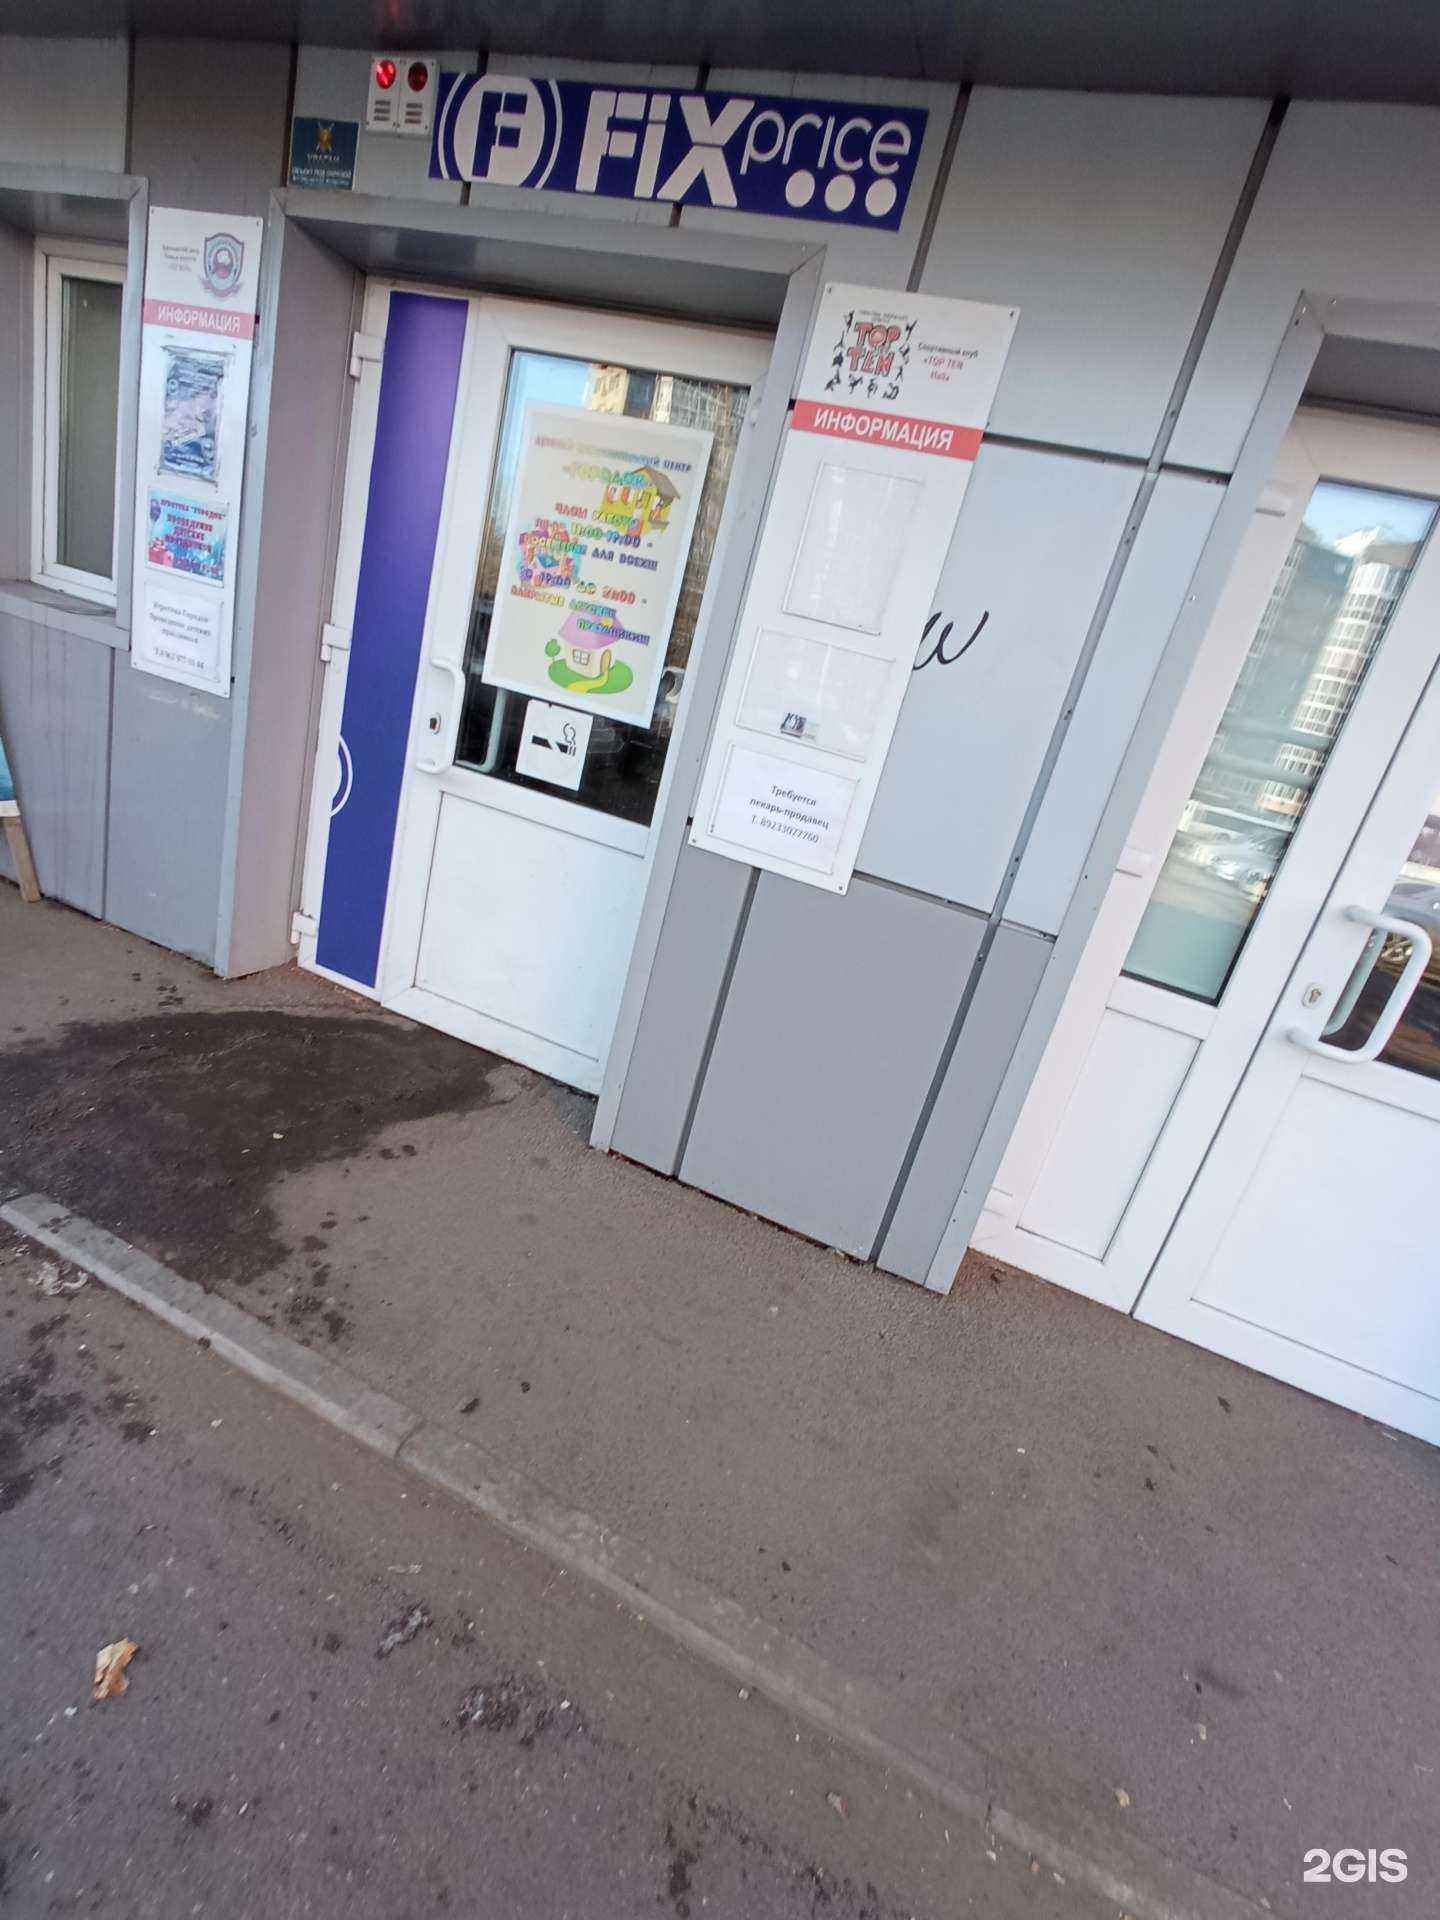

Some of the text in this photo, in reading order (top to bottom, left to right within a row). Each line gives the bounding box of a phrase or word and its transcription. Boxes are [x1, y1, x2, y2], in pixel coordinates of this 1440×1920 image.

[740, 109, 912, 176] price
[158, 304, 241, 333] ИНФОРМАЦИЯ
[854, 321, 901, 354] TOP
[847, 345, 896, 378] TEN
[813, 407, 955, 451] ИНФОРМАЦИЯ
[770, 784, 817, 807] Требуется
[749, 798, 830, 831] пекарь-продавец
